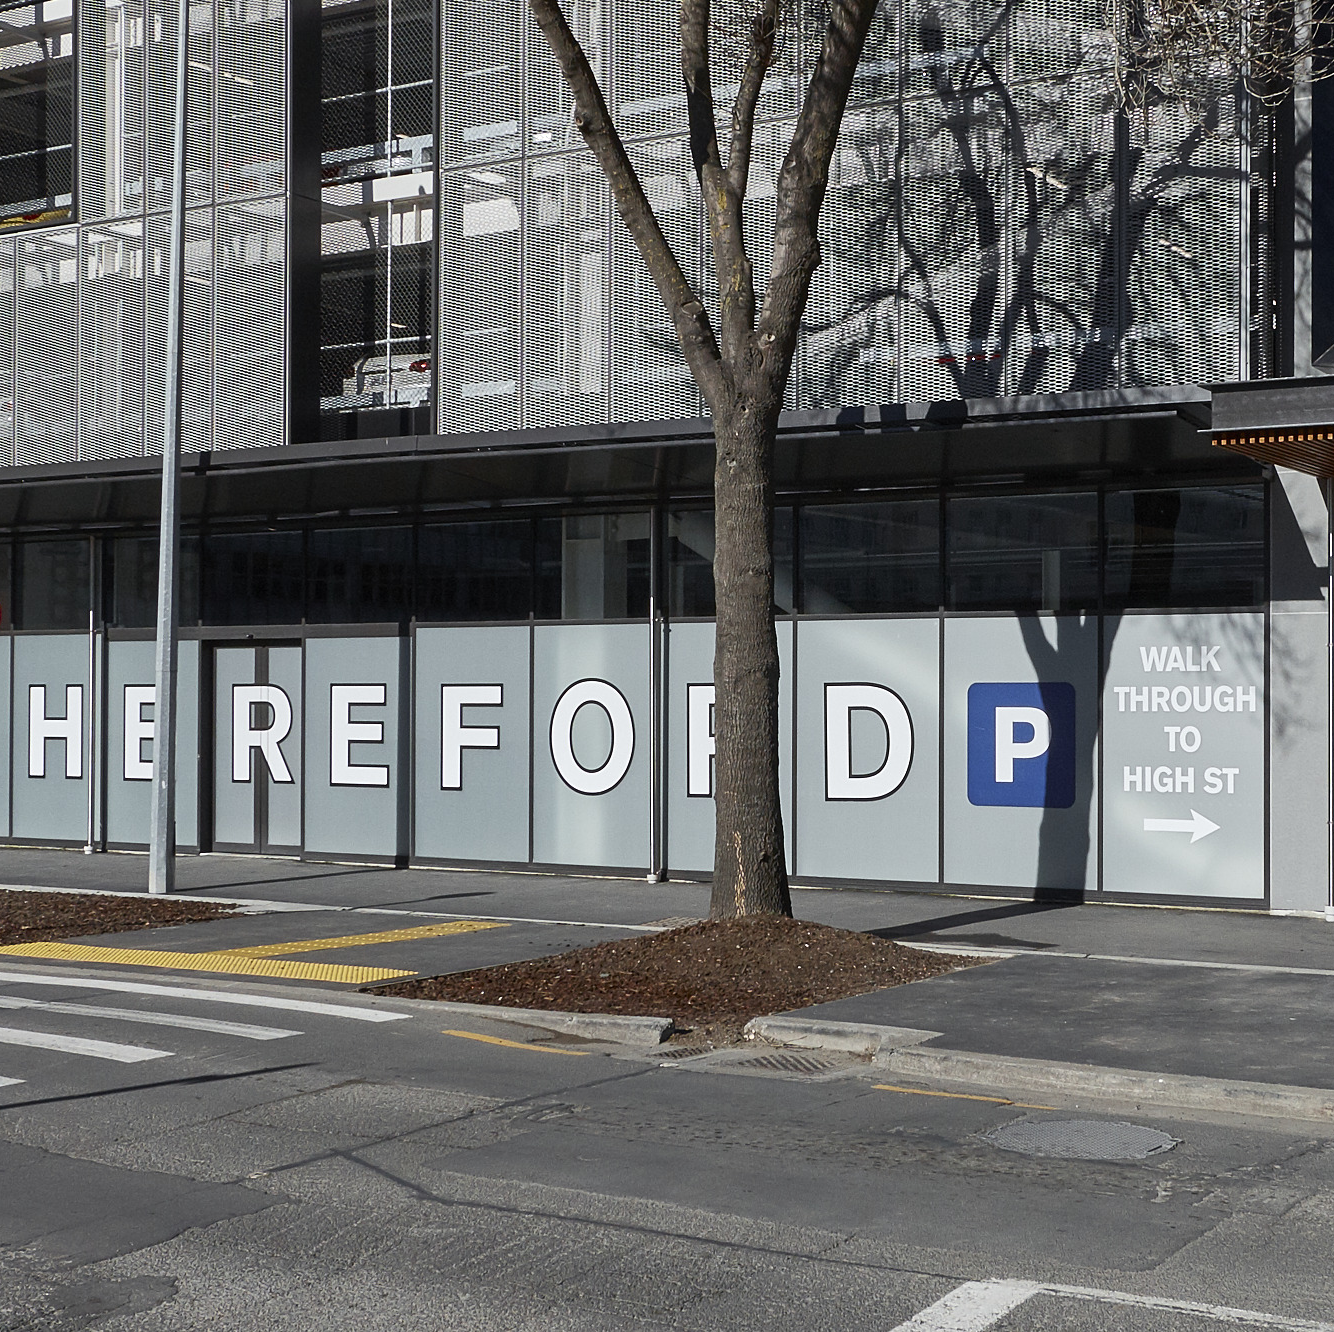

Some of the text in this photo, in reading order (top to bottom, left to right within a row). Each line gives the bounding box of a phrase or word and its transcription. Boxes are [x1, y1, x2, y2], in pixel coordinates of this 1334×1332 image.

[1140, 646, 1221, 672] WALK
[1114, 686, 1256, 712] THROUGH
[995, 706, 1051, 783] P
[1164, 726, 1202, 753] TO
[1123, 766, 1239, 794] HIGH ST
